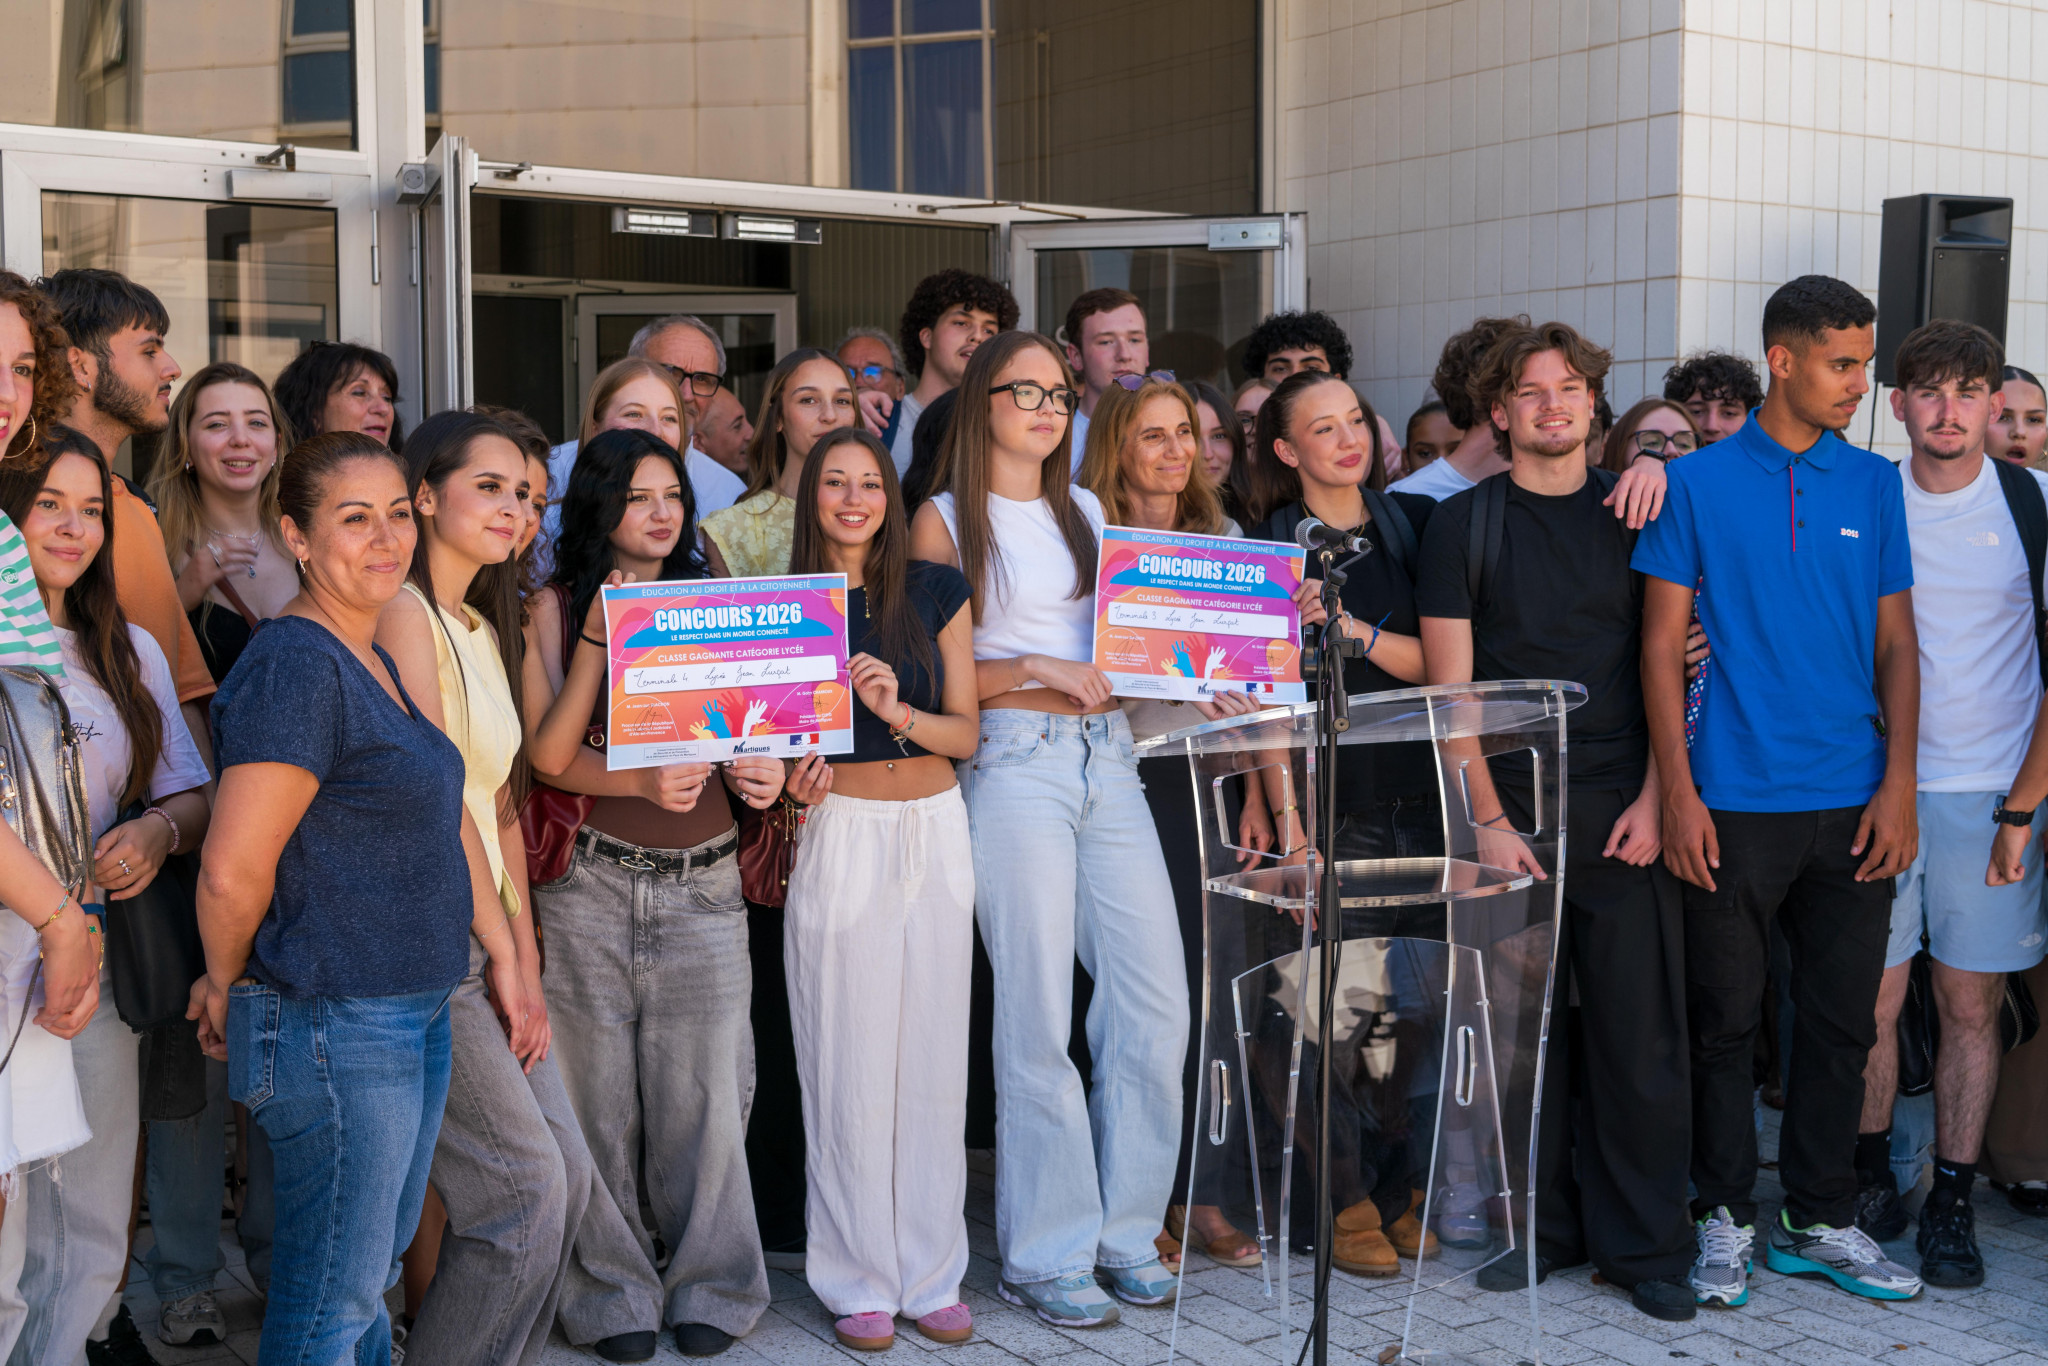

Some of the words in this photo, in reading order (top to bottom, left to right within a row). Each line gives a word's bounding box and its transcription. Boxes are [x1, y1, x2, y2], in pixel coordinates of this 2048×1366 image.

[1840, 528, 1859, 538] BOSS
[1132, 532, 1172, 542] ÉDUCATION
[1233, 544, 1276, 554] CITOYENNETÉ
[1138, 554, 1223, 580] CONCOURS
[1225, 562, 1265, 584] 2026
[642, 586, 688, 597] ÉDUCATION
[705, 585, 727, 593] DROIT
[740, 582, 745, 590] À
[760, 580, 810, 590] CITOYENNETÉ
[1224, 584, 1252, 592] CONNECTÉ
[1137, 594, 1162, 603] CLASSE
[1164, 596, 1202, 606] GAGNANTE
[1204, 598, 1241, 609] CATÉGORIE
[1243, 602, 1262, 611] LYCÉE
[655, 605, 753, 631] CONCOURS
[756, 602, 802, 626] 2026
[1152, 611, 1157, 620] 3
[756, 627, 789, 636] CONNECTÉ
[658, 654, 687, 663] CLASSE
[690, 650, 734, 660] GAGNANTE
[736, 647, 780, 658] CATÉGORIE
[781, 645, 804, 655] LYCÉE
[736, 665, 754, 684] Jean
[733, 740, 770, 753] Martigues
